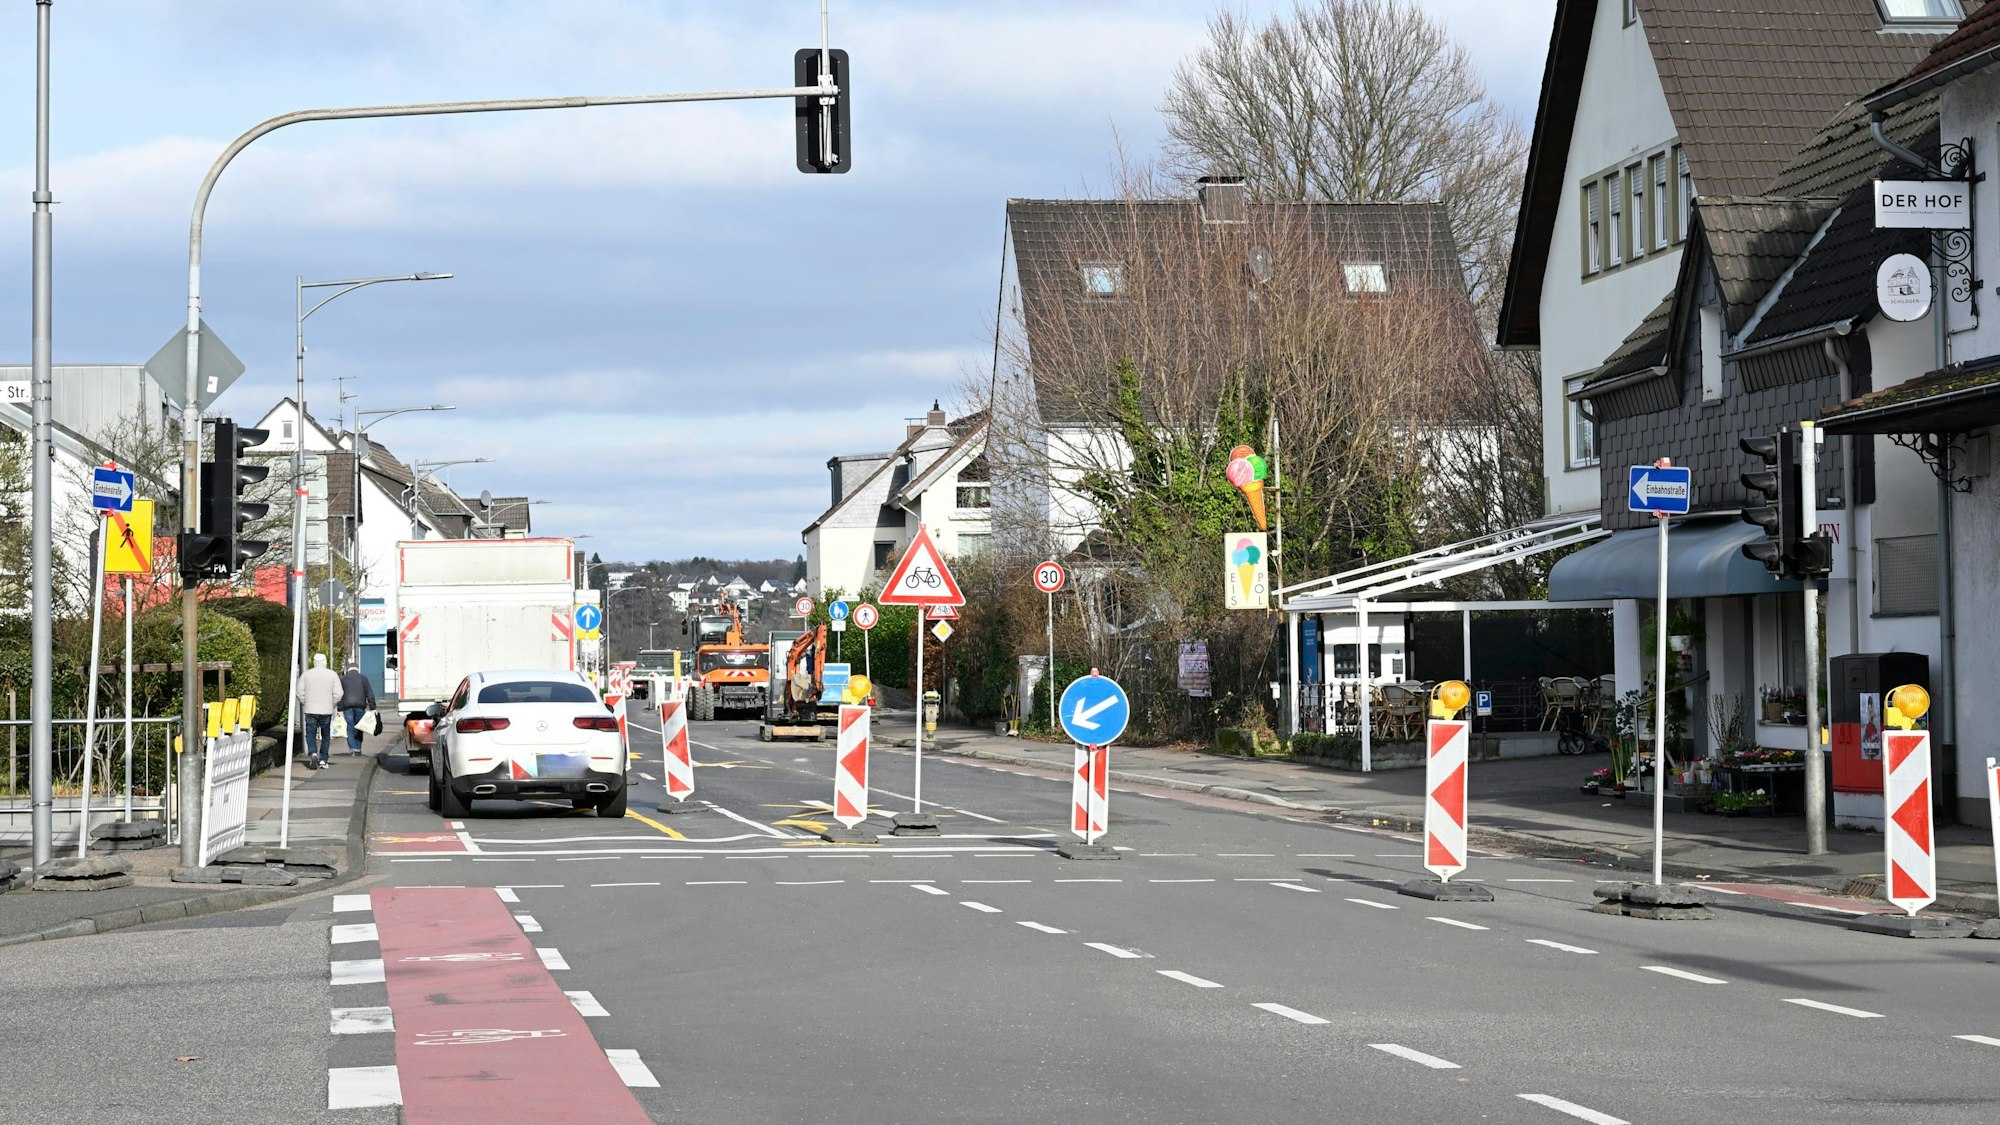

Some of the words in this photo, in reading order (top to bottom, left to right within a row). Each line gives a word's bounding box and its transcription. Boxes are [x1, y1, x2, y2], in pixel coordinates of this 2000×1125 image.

[1882, 194, 1917, 207] DER
[1925, 195, 1963, 208] HOF
[8, 385, 29, 399] Str.
[96, 483, 122, 496] Einbahnstraße
[1646, 484, 1685, 496] Einbahnstraße
[1040, 570, 1058, 583] 30
[1254, 572, 1264, 605] POL
[357, 608, 385, 616] BOSCH
[800, 602, 811, 611] 30
[1479, 693, 1489, 706] P
